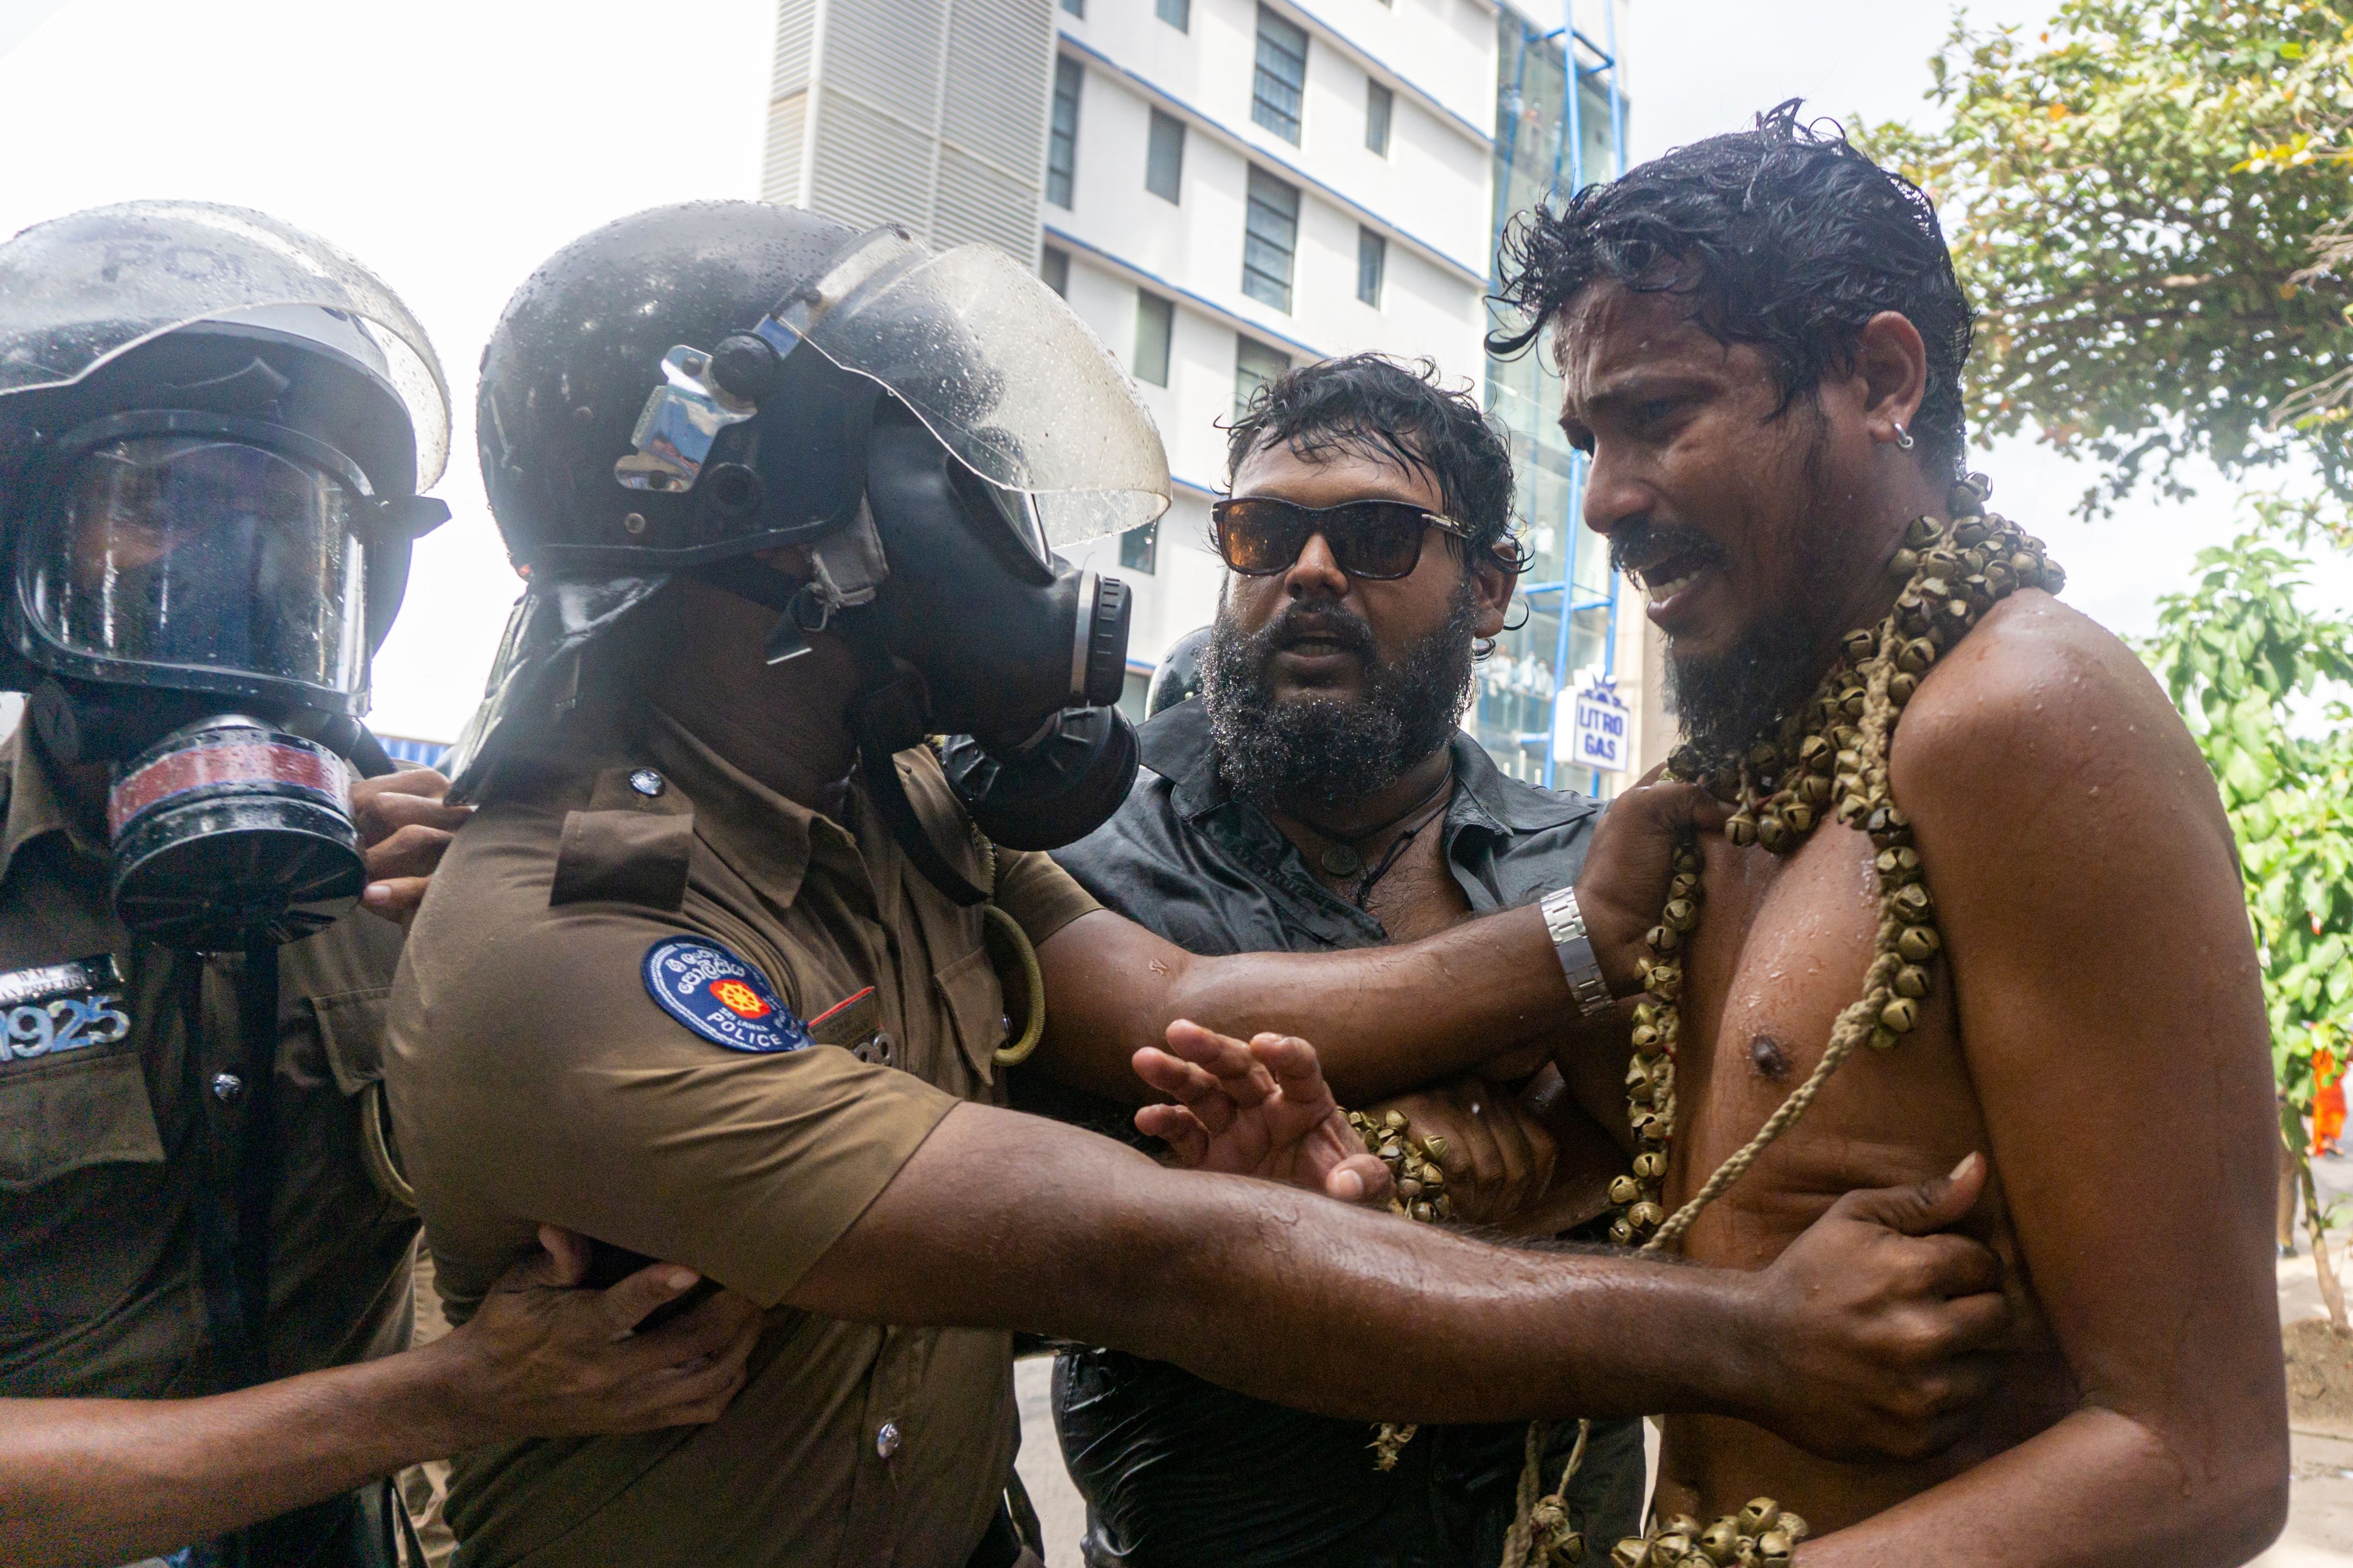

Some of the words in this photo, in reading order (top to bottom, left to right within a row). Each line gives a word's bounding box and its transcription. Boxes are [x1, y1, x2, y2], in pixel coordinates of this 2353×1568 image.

[1580, 706, 1623, 736] LITRO
[1585, 734, 1615, 760] GAS
[707, 1012, 783, 1047] POLICE
[719, 1007, 737, 1022] SRI
[737, 1020, 769, 1032] LANKA
